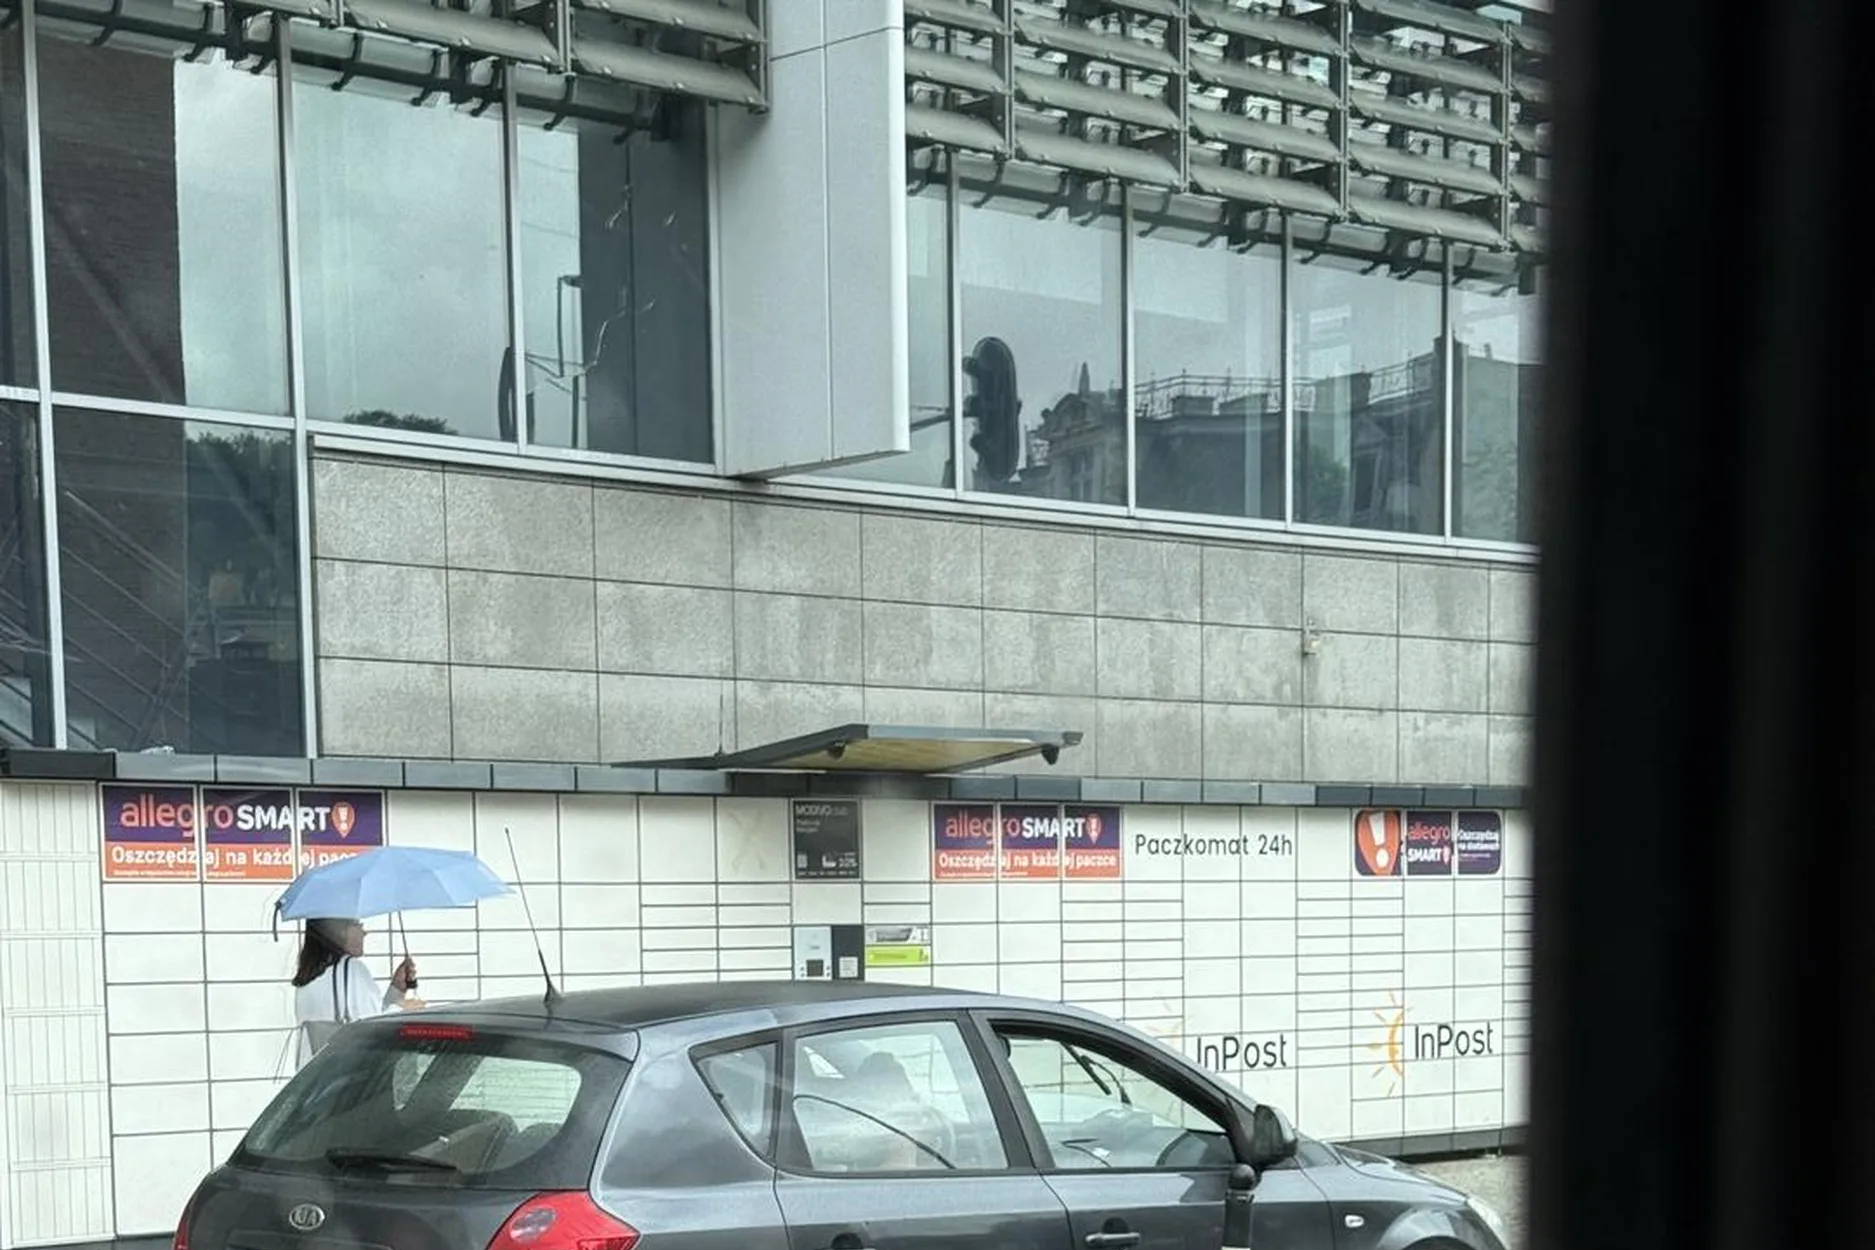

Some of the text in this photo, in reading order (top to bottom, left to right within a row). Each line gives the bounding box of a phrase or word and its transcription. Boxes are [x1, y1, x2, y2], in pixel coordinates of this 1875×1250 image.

[120, 793, 233, 837] allegro
[945, 809, 1020, 845] allegro
[1135, 833, 1293, 856] Paczkomat 24h
[1408, 821, 1450, 846] allegro
[111, 846, 219, 868] Oszczędzaj
[226, 851, 247, 865] na
[252, 848, 315, 869] każdej
[1013, 855, 1029, 867] na
[1076, 854, 1117, 871] paczce
[1197, 1033, 1287, 1072] InPost
[1414, 1021, 1493, 1061] InPost
